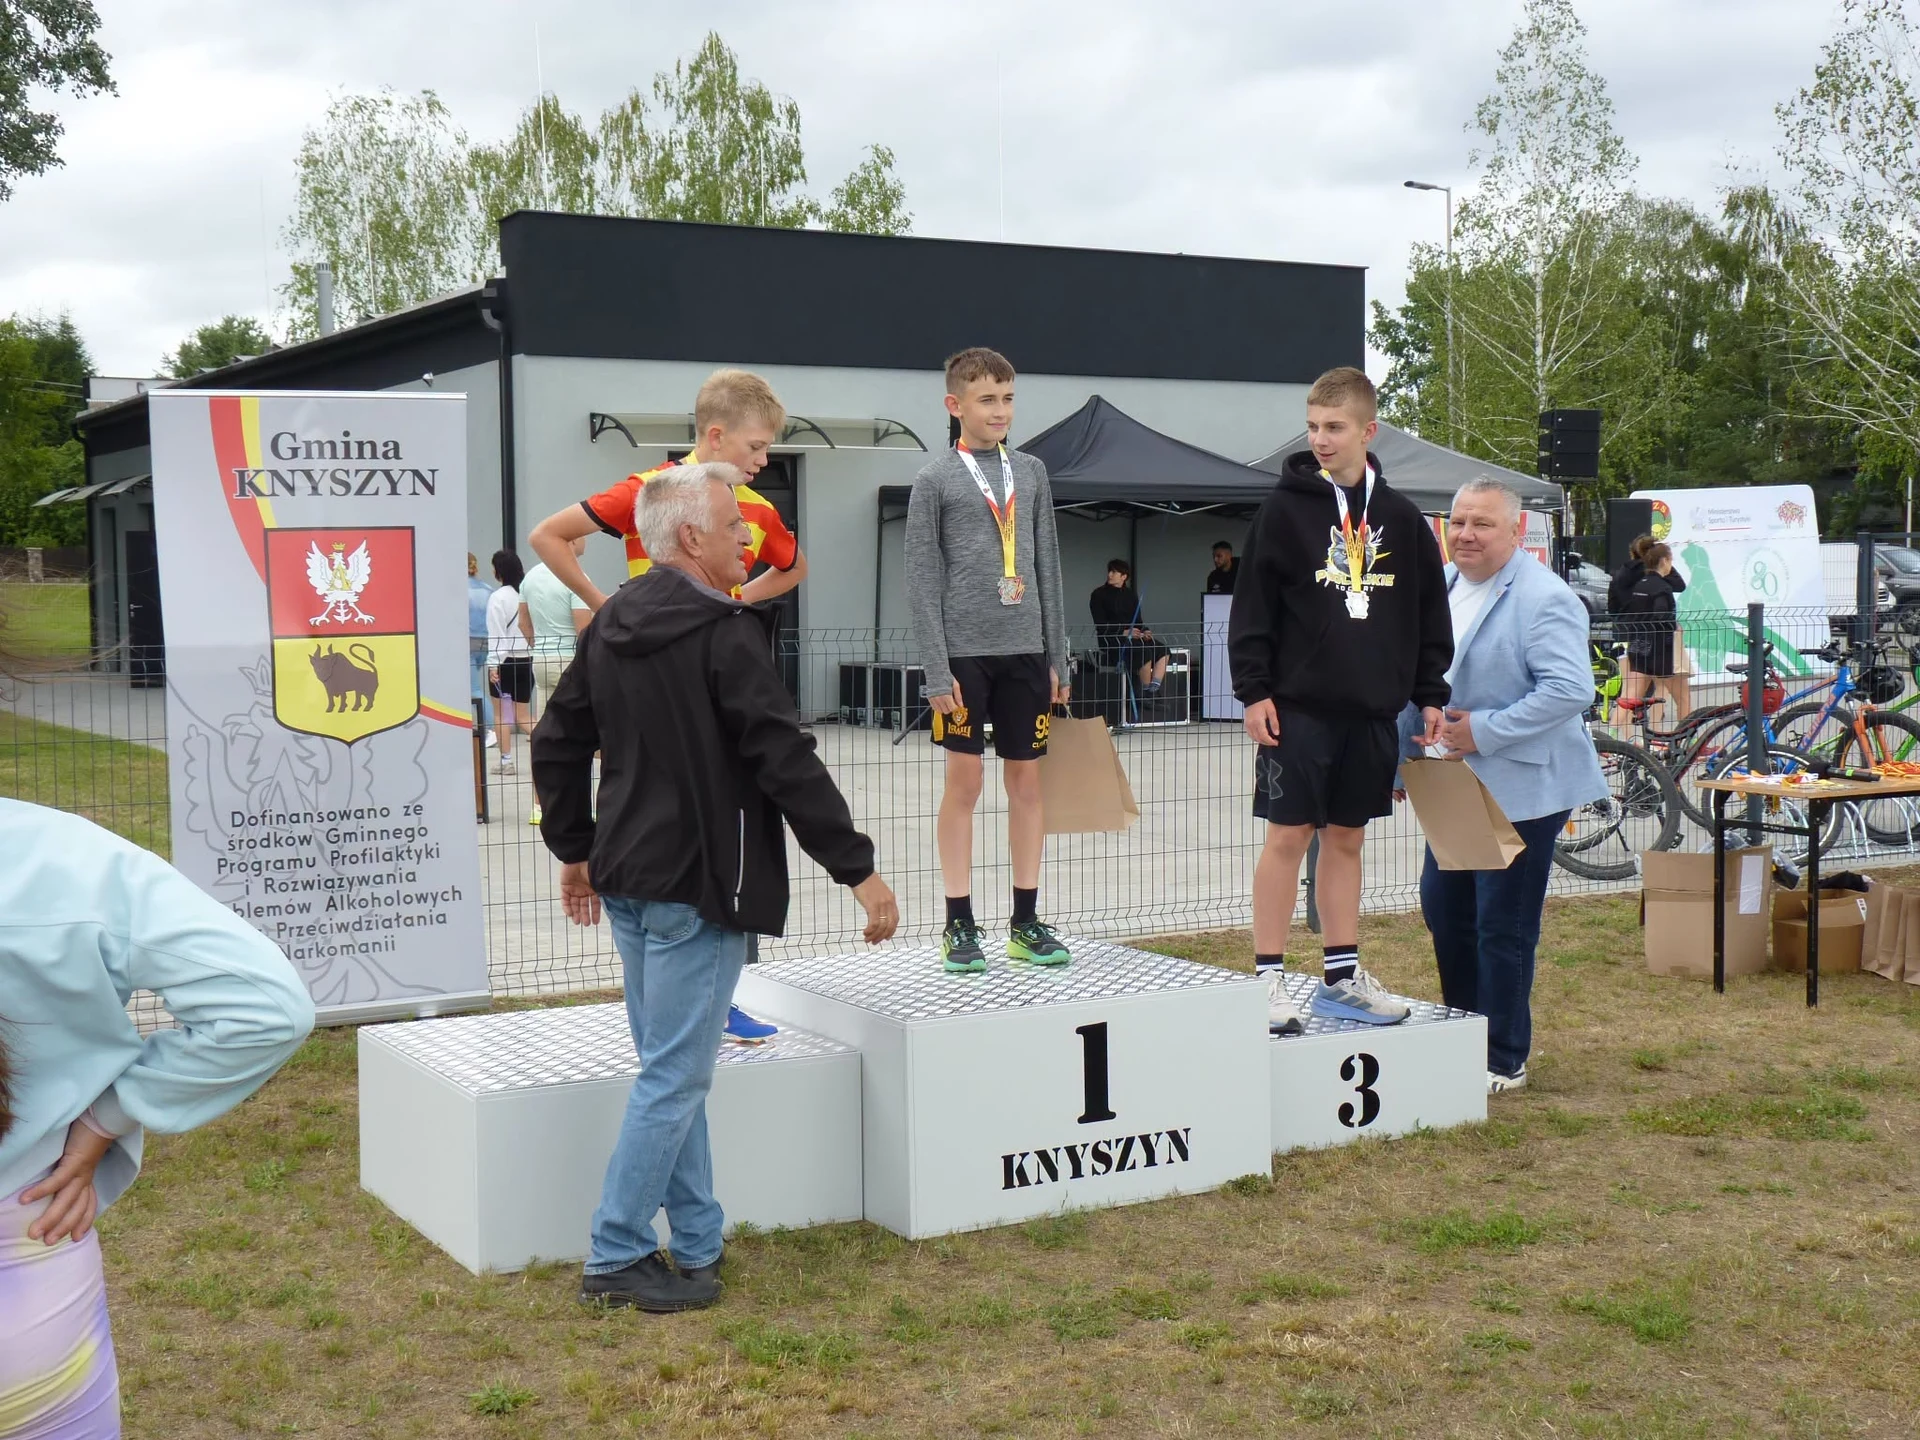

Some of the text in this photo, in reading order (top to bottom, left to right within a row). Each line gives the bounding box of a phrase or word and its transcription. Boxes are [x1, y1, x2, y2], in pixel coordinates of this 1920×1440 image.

[270, 430, 403, 461] Gmina
[234, 468, 438, 498] KNYSZYN
[231, 803, 424, 828] Dofinansowano ze
[227, 826, 429, 851] środków Gminnego
[217, 843, 441, 877] Programu Profilaktyki
[244, 868, 417, 896] i Rozwiązywania
[233, 886, 463, 918] blemów Alkoholowych
[276, 911, 447, 938] Przeciwdziałania
[1075, 1022, 1117, 1125] 1
[1337, 1052, 1381, 1129] 3
[1001, 1127, 1191, 1190] KNYSZYN
